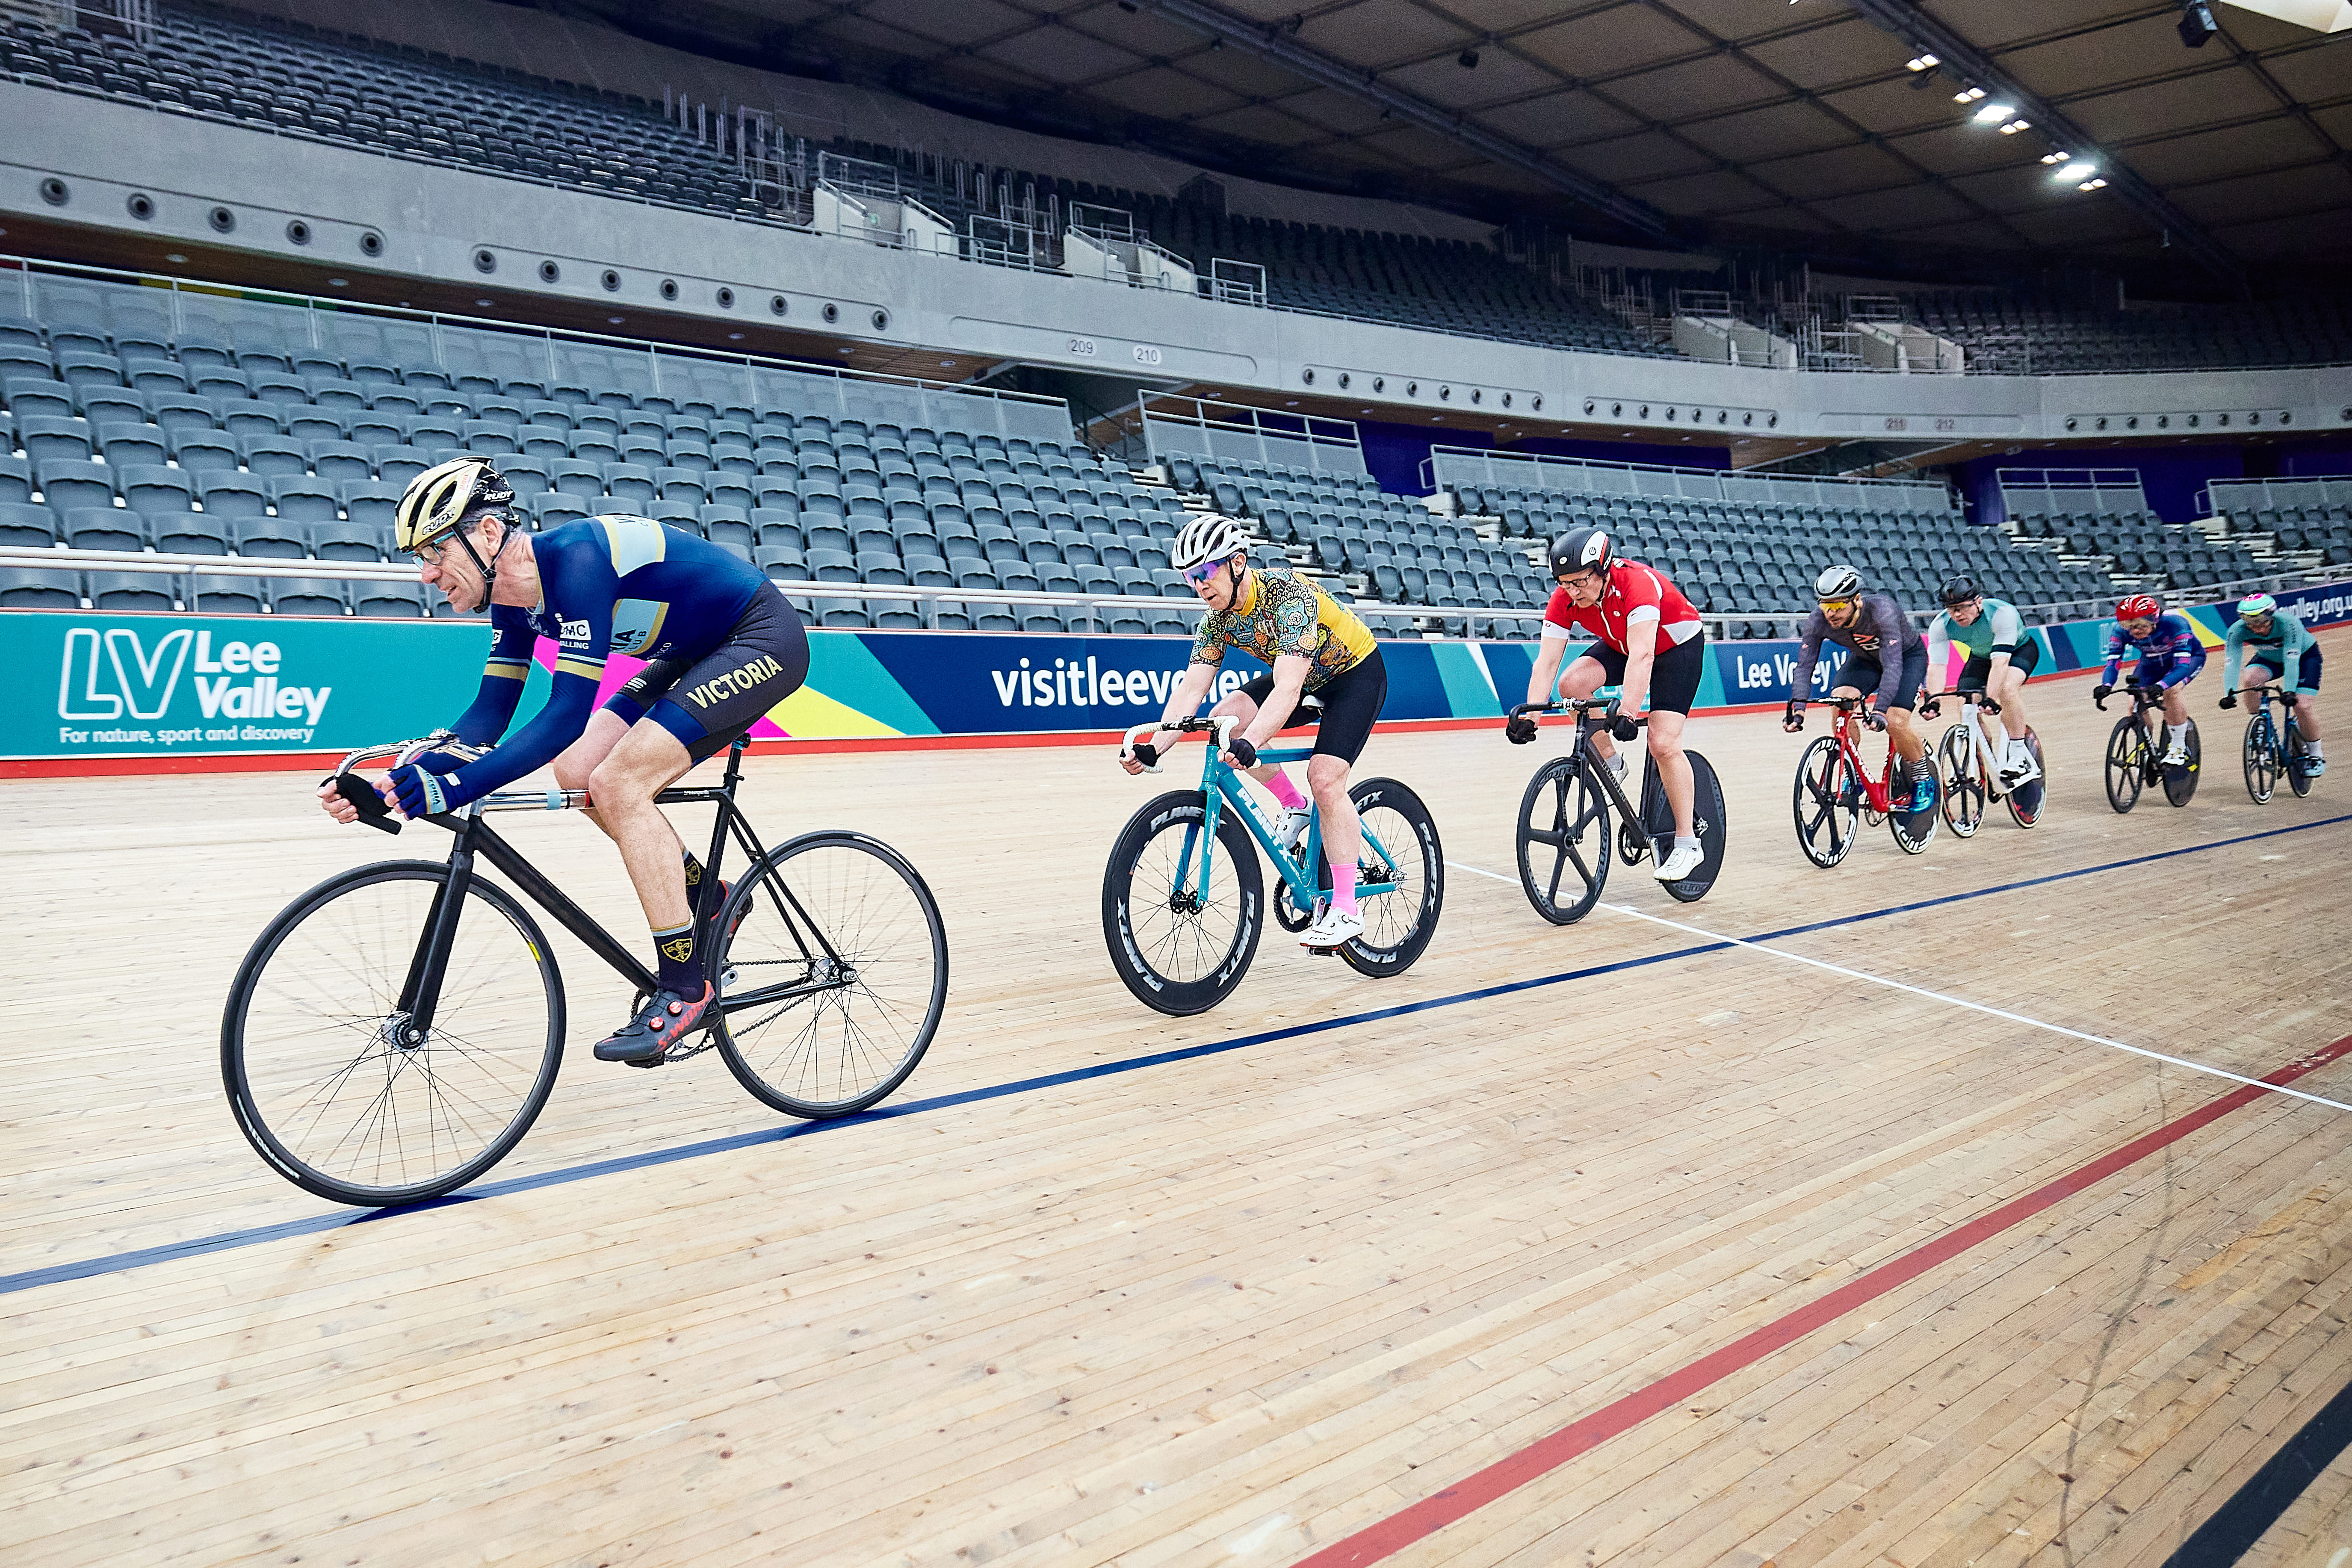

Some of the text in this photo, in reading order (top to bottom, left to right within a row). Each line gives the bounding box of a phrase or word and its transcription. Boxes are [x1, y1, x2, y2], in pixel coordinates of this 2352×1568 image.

[1071, 339, 1093, 354] 209
[1136, 348, 1158, 362] 210
[1886, 418, 1905, 431] 211
[483, 490, 514, 501] RUDY
[422, 507, 456, 535] RUDY
[194, 630, 281, 673] Lee
[58, 628, 194, 720] LV
[686, 655, 783, 709] VICTORIA
[1737, 655, 1773, 688] Lee
[194, 676, 332, 726] Valley
[59, 724, 314, 745] For nature, sport and discovery
